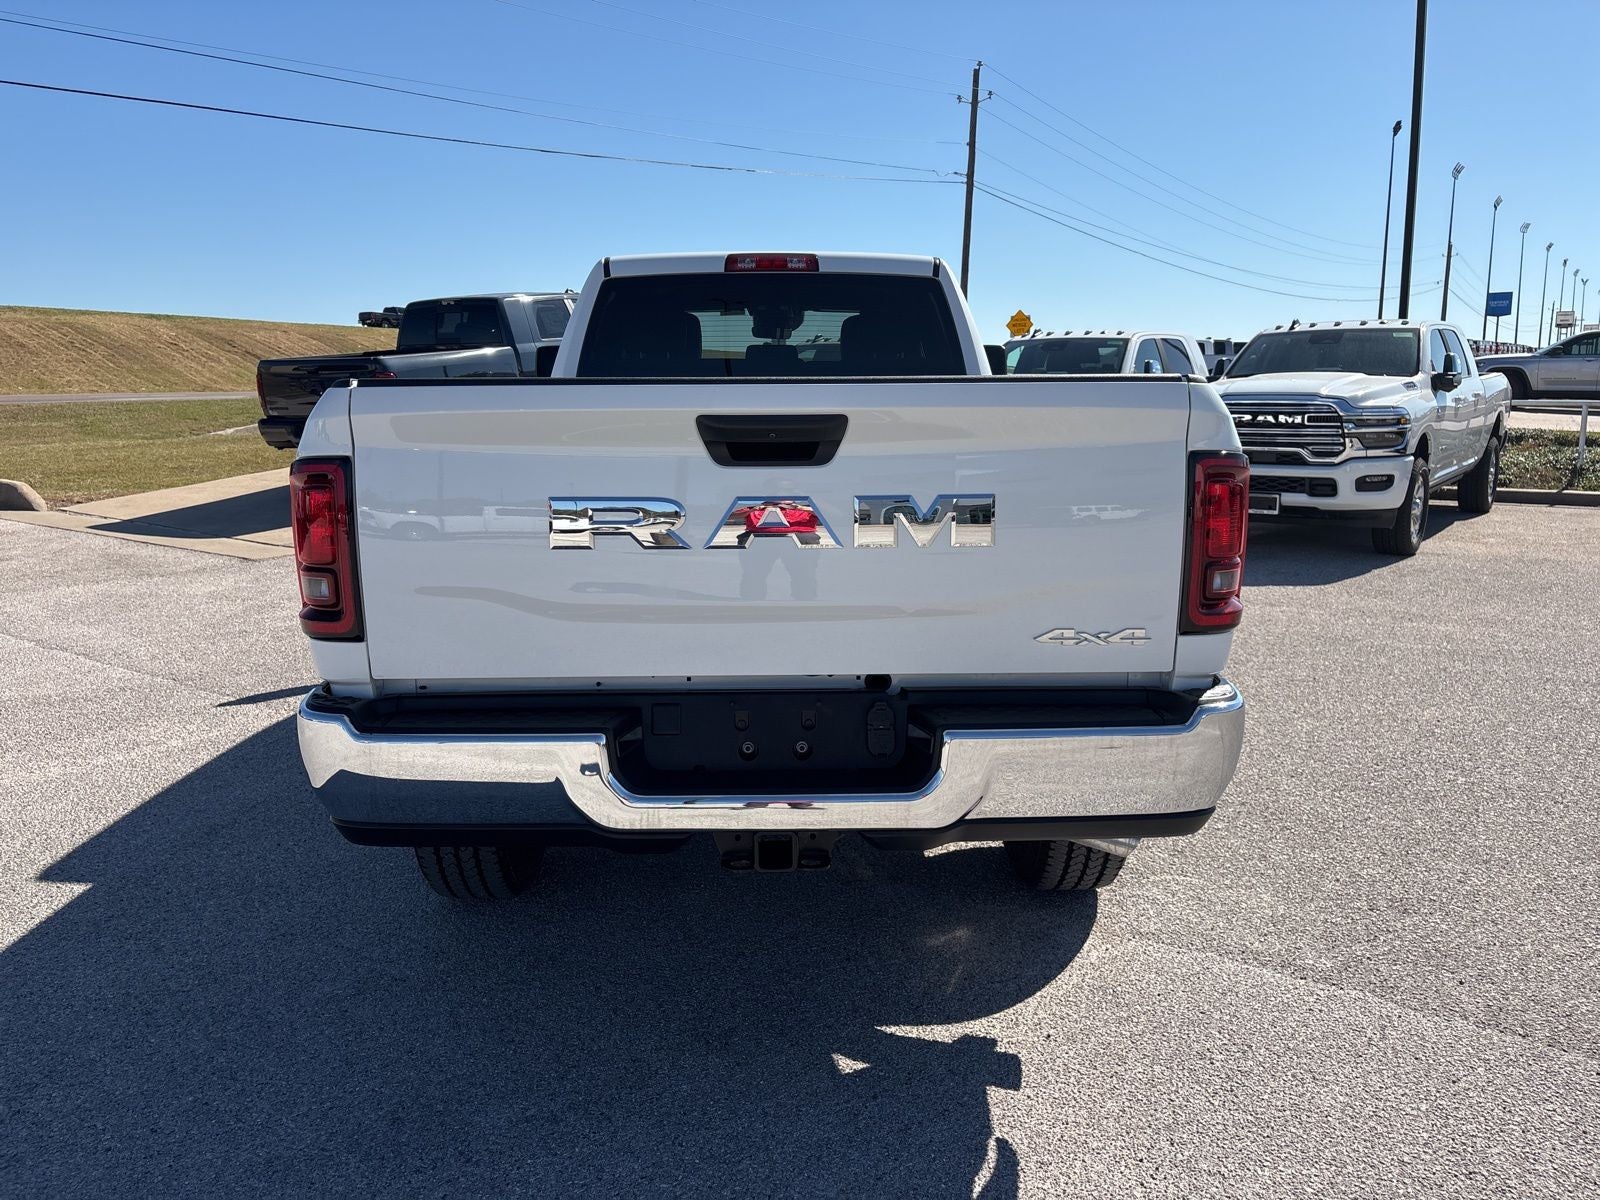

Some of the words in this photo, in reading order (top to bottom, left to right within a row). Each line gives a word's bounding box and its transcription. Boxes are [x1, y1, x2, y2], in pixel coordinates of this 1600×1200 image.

[1231, 414, 1303, 424] RAM
[548, 494, 996, 550] RAM
[1033, 627, 1152, 646] 4x4
